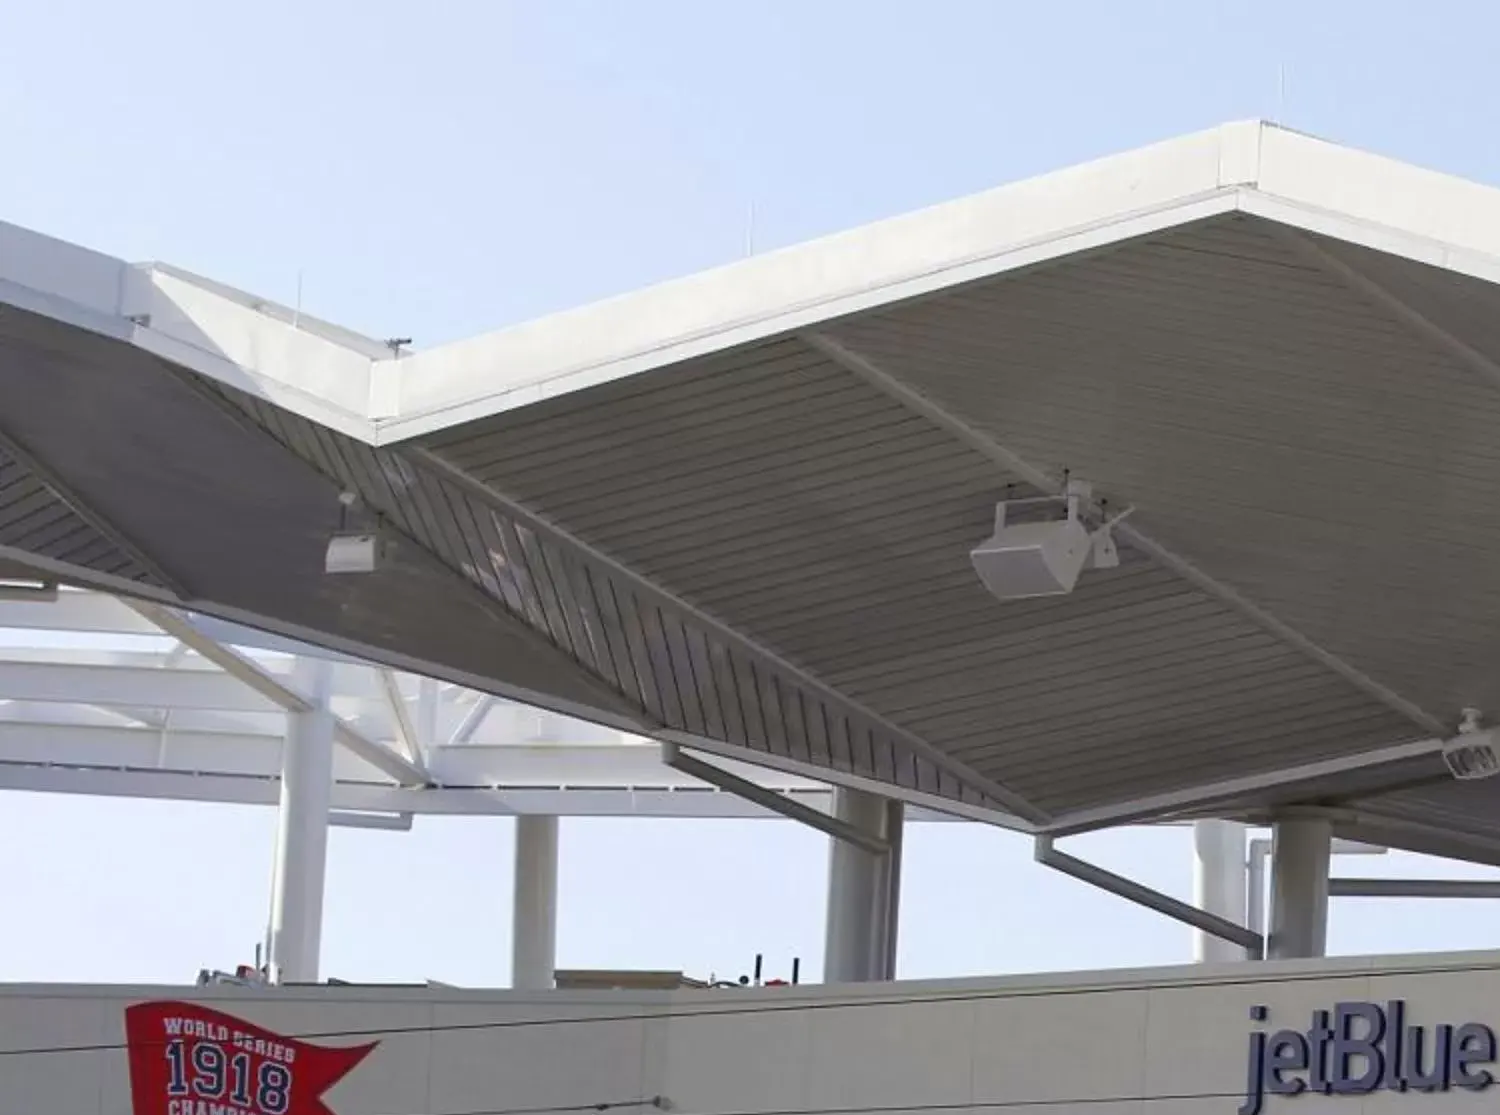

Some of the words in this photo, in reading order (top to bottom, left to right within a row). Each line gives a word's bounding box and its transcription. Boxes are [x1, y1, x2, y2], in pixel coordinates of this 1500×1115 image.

[163, 1016, 229, 1042] WORLD
[232, 1029, 296, 1064] SERIES
[166, 1038, 292, 1115] 1918
